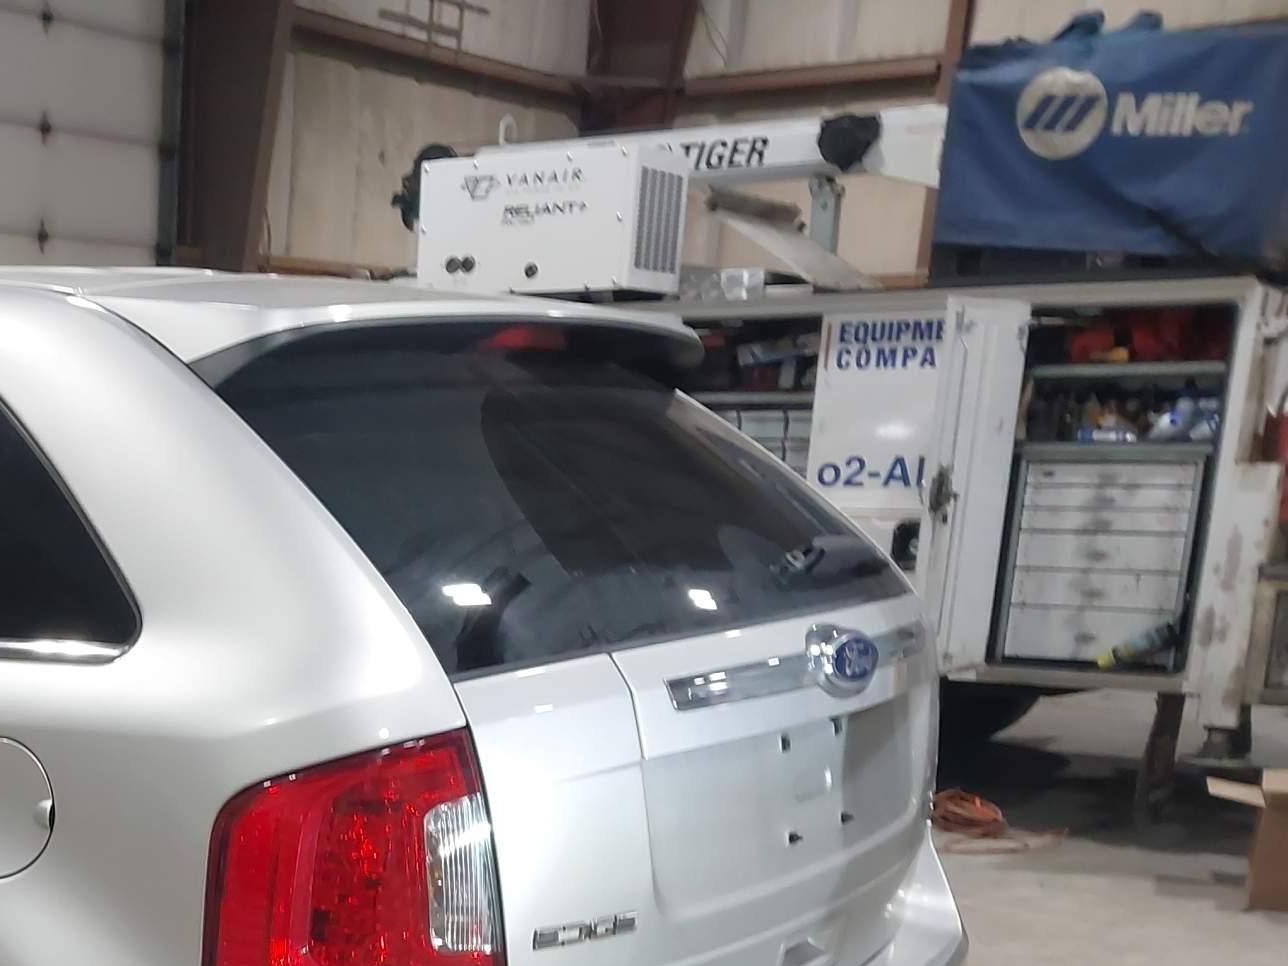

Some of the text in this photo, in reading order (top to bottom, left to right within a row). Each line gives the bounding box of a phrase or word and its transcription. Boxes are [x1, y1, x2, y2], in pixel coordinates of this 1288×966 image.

[1111, 92, 1254, 137] Miller
[679, 136, 768, 170] TIGER
[505, 168, 584, 186] VANAIR
[836, 347, 936, 369] COMPA
